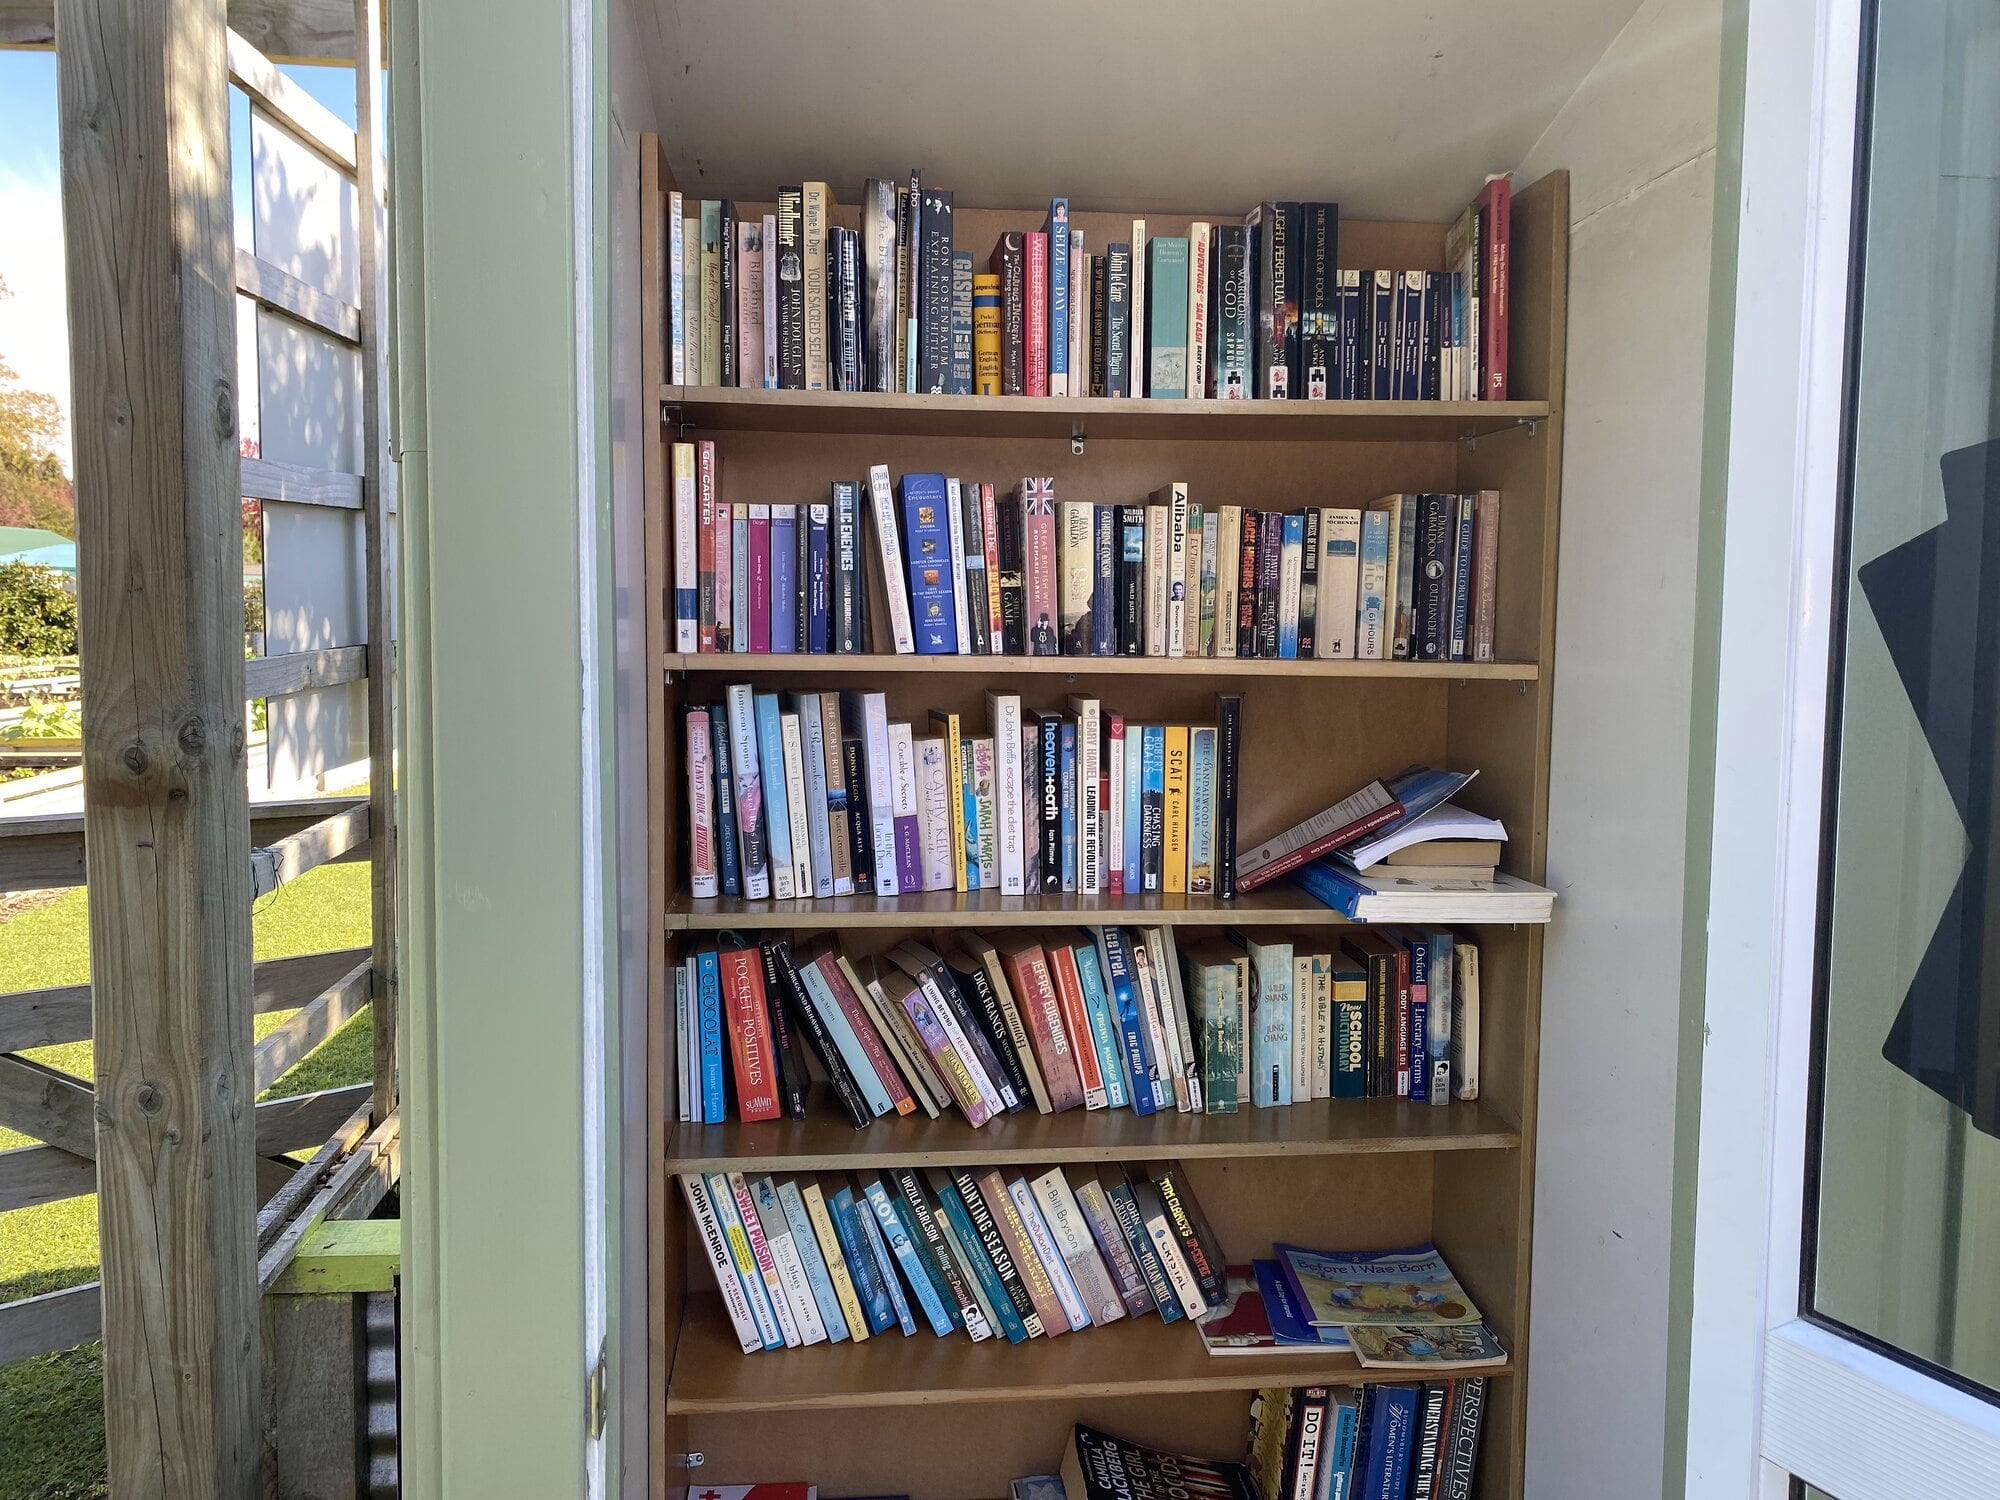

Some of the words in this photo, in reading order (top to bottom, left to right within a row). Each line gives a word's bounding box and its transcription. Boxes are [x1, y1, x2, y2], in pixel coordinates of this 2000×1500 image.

[809, 192, 820, 202] Dr.
[911, 177, 920, 207] zarbo
[779, 192, 800, 247] Mindhunter
[806, 204, 820, 227] Wayne
[1275, 210, 1284, 243] LIGHT
[806, 240, 819, 255] Dyer
[808, 229, 819, 238] W.
[1055, 226, 1065, 266] SEIZE
[940, 236, 949, 266] RON
[1111, 252, 1128, 272] John
[809, 268, 820, 295] YOUR
[930, 231, 939, 317] EXPLAINING
[1055, 269, 1065, 284] the
[1197, 241, 1206, 294] ADVENTURES
[1230, 270, 1236, 278] OF
[1275, 246, 1284, 308] PERPETUAL
[750, 261, 760, 326] Blackbird
[791, 288, 801, 314] JOHN
[953, 260, 972, 325] GASPIPE
[1055, 287, 1065, 313] DAY
[1225, 280, 1236, 318] GOD
[1237, 268, 1246, 326] WARRIORS
[809, 297, 820, 334] SACRED
[940, 276, 949, 366] ROSENBAUM
[1112, 316, 1124, 330] The
[723, 325, 731, 343] Ewing
[791, 316, 801, 376] DOUGLAS
[809, 337, 820, 359] SELF
[930, 322, 939, 370] HITLER
[1112, 332, 1124, 350] Secret
[723, 353, 731, 375] Stevens
[1110, 352, 1124, 376] Pilgrim
[1493, 373, 1502, 388] IPS
[840, 485, 853, 522] PUBLIC
[1070, 508, 1080, 548] GABALDON
[1080, 518, 1088, 540] DIANA
[1101, 511, 1110, 545] CATHERINE
[1174, 490, 1186, 552] Alibaba
[1427, 502, 1440, 556] GABALDON
[1438, 516, 1447, 544] DIANA
[840, 525, 853, 571] ENEMIES
[1101, 548, 1110, 578] COOKSON
[1004, 592, 1015, 626] GAME
[1368, 612, 1376, 621] 61
[1427, 584, 1437, 638] OUTLANDER
[1368, 624, 1376, 655] HOURS
[738, 690, 748, 731] Innocent
[1005, 706, 1014, 716] Dr
[1006, 718, 1014, 740] John
[1087, 721, 1096, 746] GARY
[740, 736, 752, 769] Spouse
[898, 742, 908, 774] Crucible
[1006, 743, 1016, 764] Briffa
[1087, 748, 1096, 780] HAMEL
[1144, 736, 1154, 773] CRAIS
[1154, 736, 1162, 773] ROBERT
[1170, 750, 1182, 782] SCAT
[1004, 768, 1014, 798] escape
[1045, 722, 1058, 820] heaven+earth
[747, 784, 756, 811] Carol
[900, 784, 910, 810] Secrets
[1007, 800, 1016, 814] the
[1086, 786, 1096, 820] LEADING
[724, 824, 732, 840] JOEL
[750, 816, 758, 836] Ross
[875, 824, 884, 848] Lion's
[886, 832, 893, 844] In
[1008, 816, 1016, 833] diet
[1086, 822, 1096, 837] THE
[1143, 804, 1152, 849] DARKNESS
[1152, 808, 1160, 846] CHASING
[725, 841, 733, 867] OSTEEN
[749, 840, 760, 866] Joynt
[876, 850, 884, 868] Den
[1006, 836, 1016, 853] trap
[1086, 840, 1096, 888] REVOLUTION
[1415, 948, 1426, 982] Oxford
[735, 958, 753, 1012] POCKET
[703, 974, 719, 1056] CHOCOLAT
[788, 970, 802, 992] DRUGS
[797, 992, 807, 1006] AND
[803, 1006, 822, 1037] BEHAVIOR
[973, 971, 990, 998] DICK
[983, 997, 1004, 1039] FRANCIS
[1031, 960, 1052, 999] JEFFREY
[1044, 1000, 1068, 1055] EUGENIDES
[1128, 1032, 1137, 1046] ERIC
[1338, 1012, 1350, 1072] DICTIONARY
[1350, 1012, 1362, 1072] SCHOOL
[1412, 1008, 1424, 1048] Literary
[743, 1020, 762, 1085] POSITIVES
[1131, 1048, 1144, 1074] PHILIPS
[1414, 1052, 1424, 1084] Terms
[708, 1064, 718, 1088] Joanne
[870, 1190, 898, 1226] ROY
[900, 1176, 922, 1206] URZILA
[915, 1208, 940, 1242] CARLSON
[1047, 1189, 1062, 1208] Bill
[1056, 1209, 1080, 1250] Bryson
[1168, 1198, 1193, 1238] CLANCY'S
[690, 1182, 708, 1213] JOHN
[702, 1216, 728, 1268] McENROE
[736, 1189, 754, 1228] SWEET
[747, 1229, 774, 1272] POISON
[956, 1174, 992, 1232] HUNTING
[982, 1230, 1016, 1282] SEASON
[1161, 1241, 1186, 1290] CRYSTAL
[1297, 1259, 1348, 1274] Before
[1350, 1263, 1356, 1274] I
[1359, 1262, 1394, 1274] Was
[1398, 1261, 1438, 1272] Born
[727, 1274, 735, 1286] BUT
[733, 1288, 748, 1322] SERIOUSLY
[1304, 1412, 1320, 1433] DO
[1420, 1390, 1444, 1470] UNDERSTANDING
[1452, 1378, 1483, 1499] PERSPECTIVES
[1300, 1439, 1316, 1467] IT!
